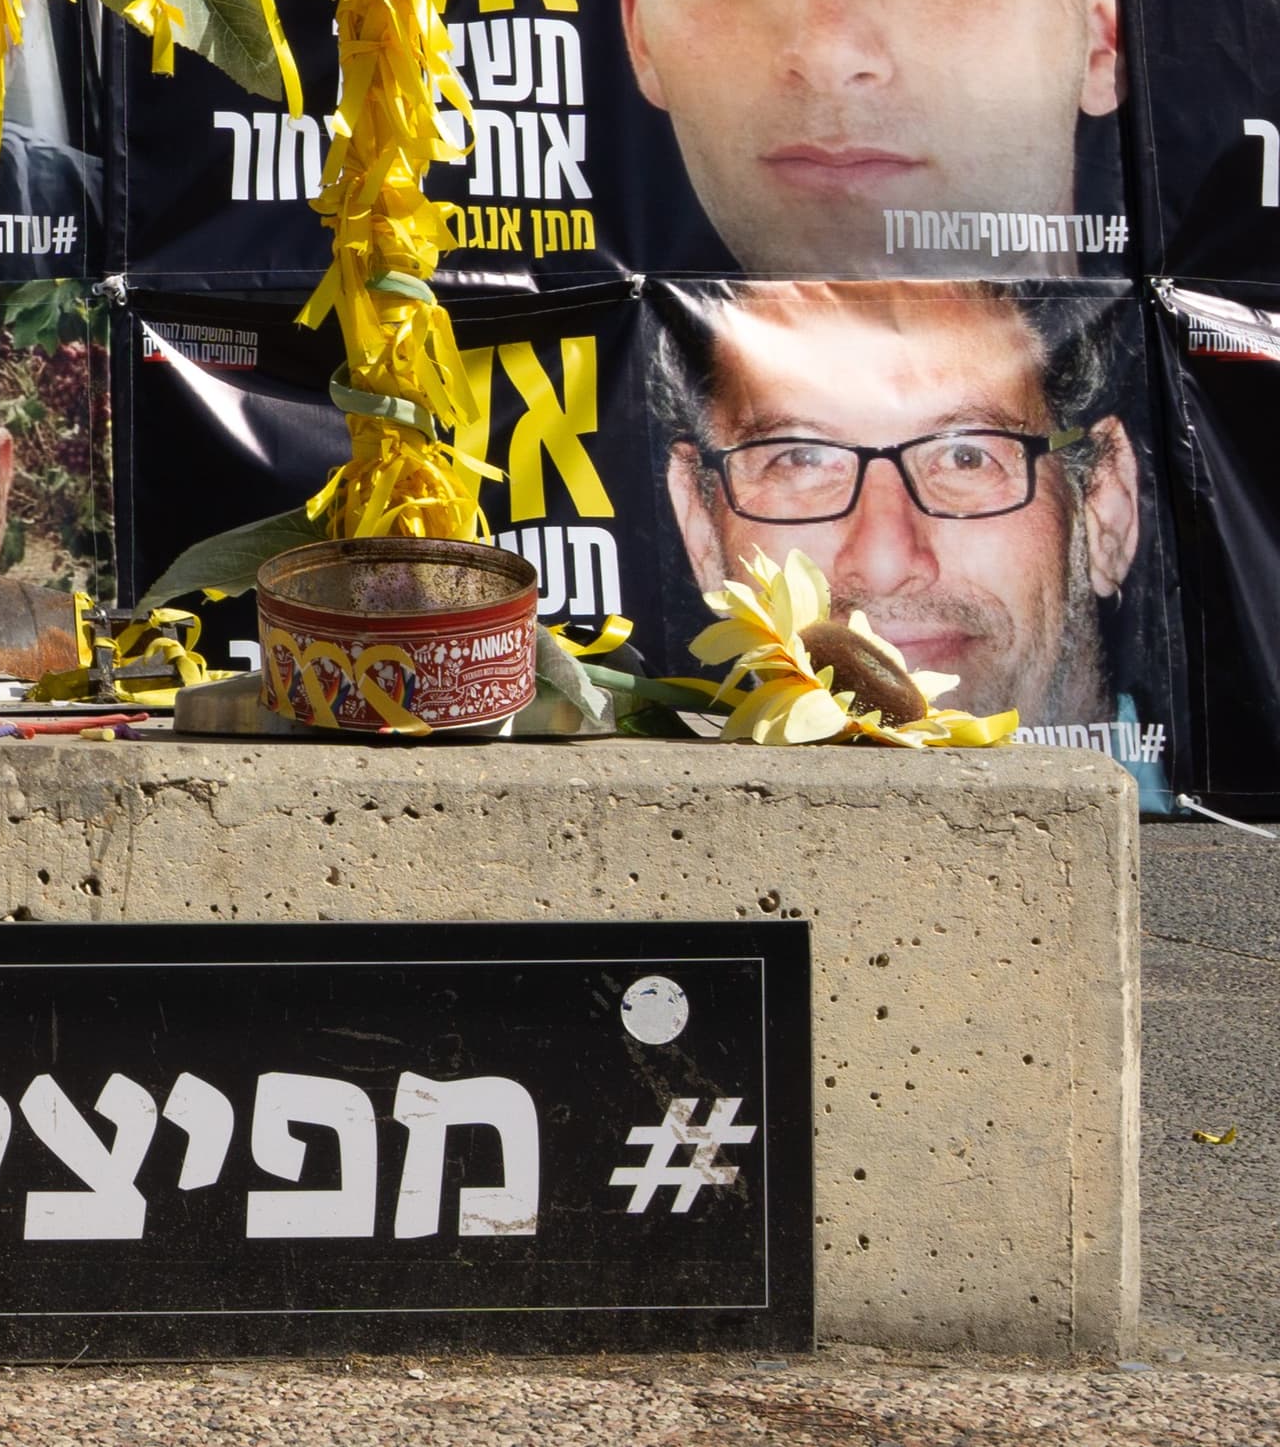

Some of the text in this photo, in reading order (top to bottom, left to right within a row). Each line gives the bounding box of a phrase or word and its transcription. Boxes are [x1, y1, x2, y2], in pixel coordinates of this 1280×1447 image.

[530, 209, 596, 258] מתן
[883, 209, 1129, 257] #עדהחטוףהאחרון
[182, 324, 233, 342] המשפחות
[235, 330, 258, 346] מטה
[201, 343, 258, 366] החטופים
[471, 629, 514, 662] ANNAS
